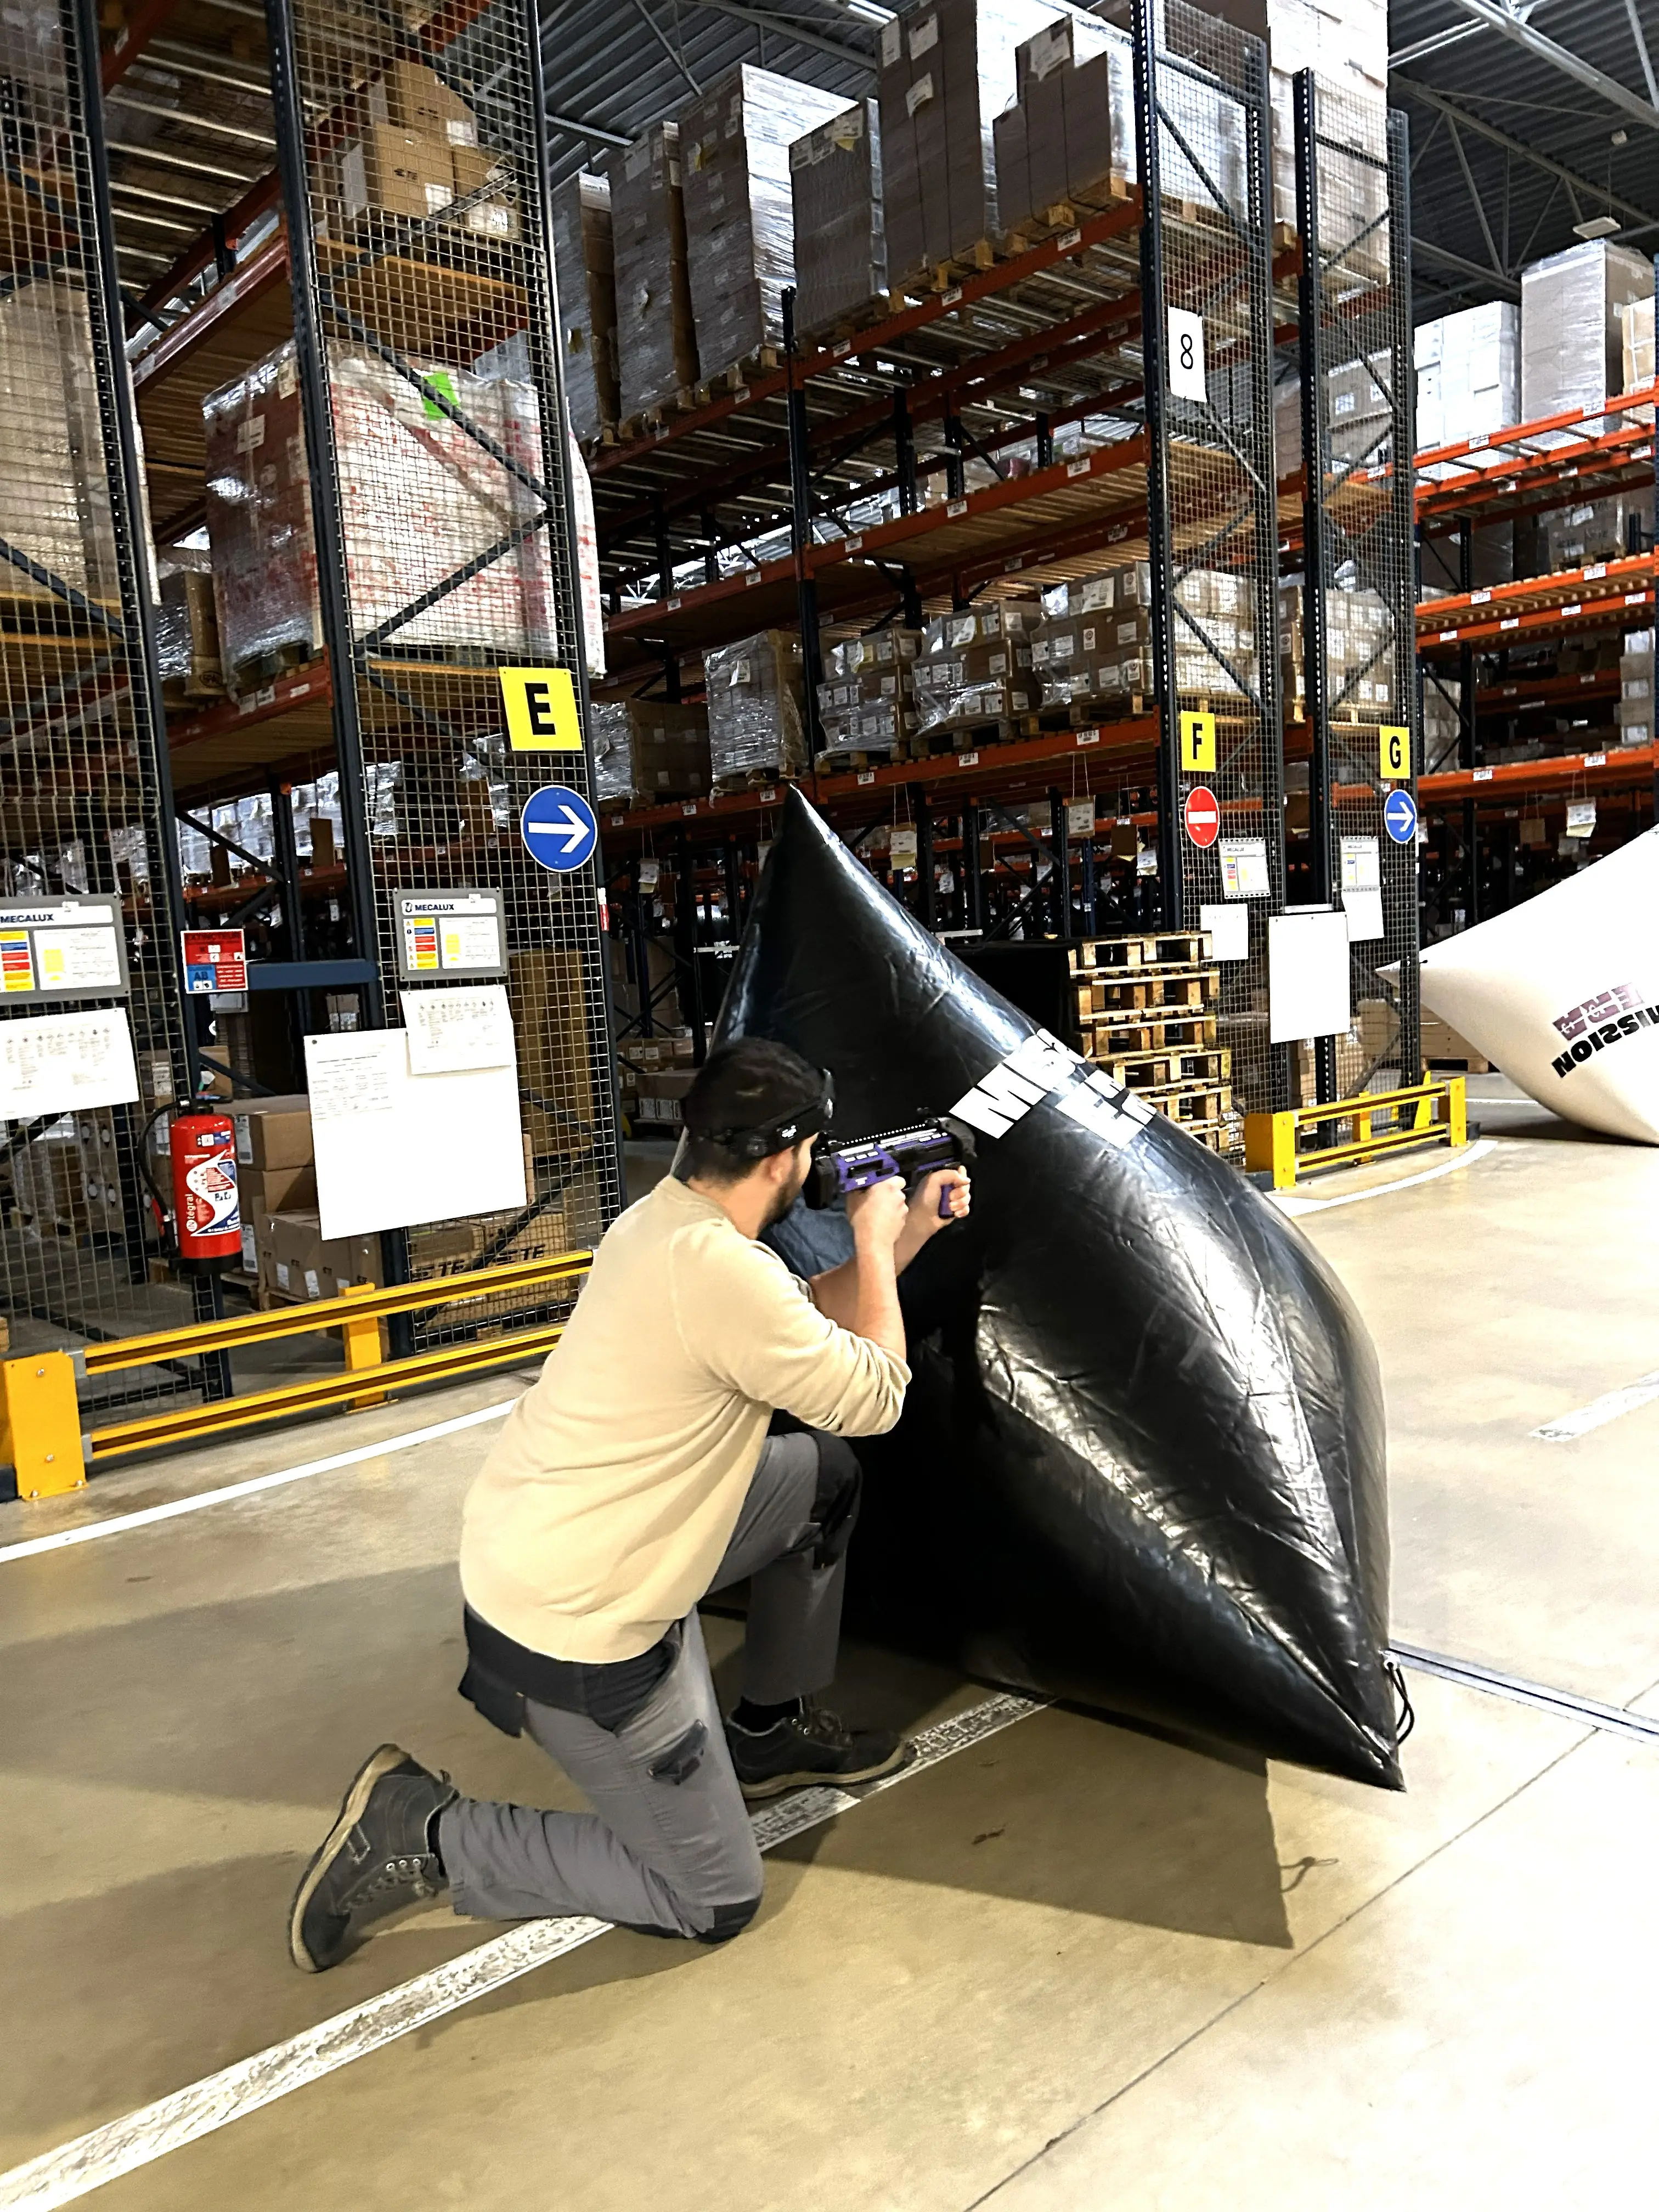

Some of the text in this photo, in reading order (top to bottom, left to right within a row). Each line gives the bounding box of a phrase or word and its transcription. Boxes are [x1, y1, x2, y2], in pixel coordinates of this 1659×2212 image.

[1181, 334, 1193, 369] 8
[524, 682, 556, 736] E
[1192, 723, 1202, 759] F
[1389, 736, 1401, 769] G
[0, 913, 54, 923] MECALUX
[194, 971, 208, 980] AB
